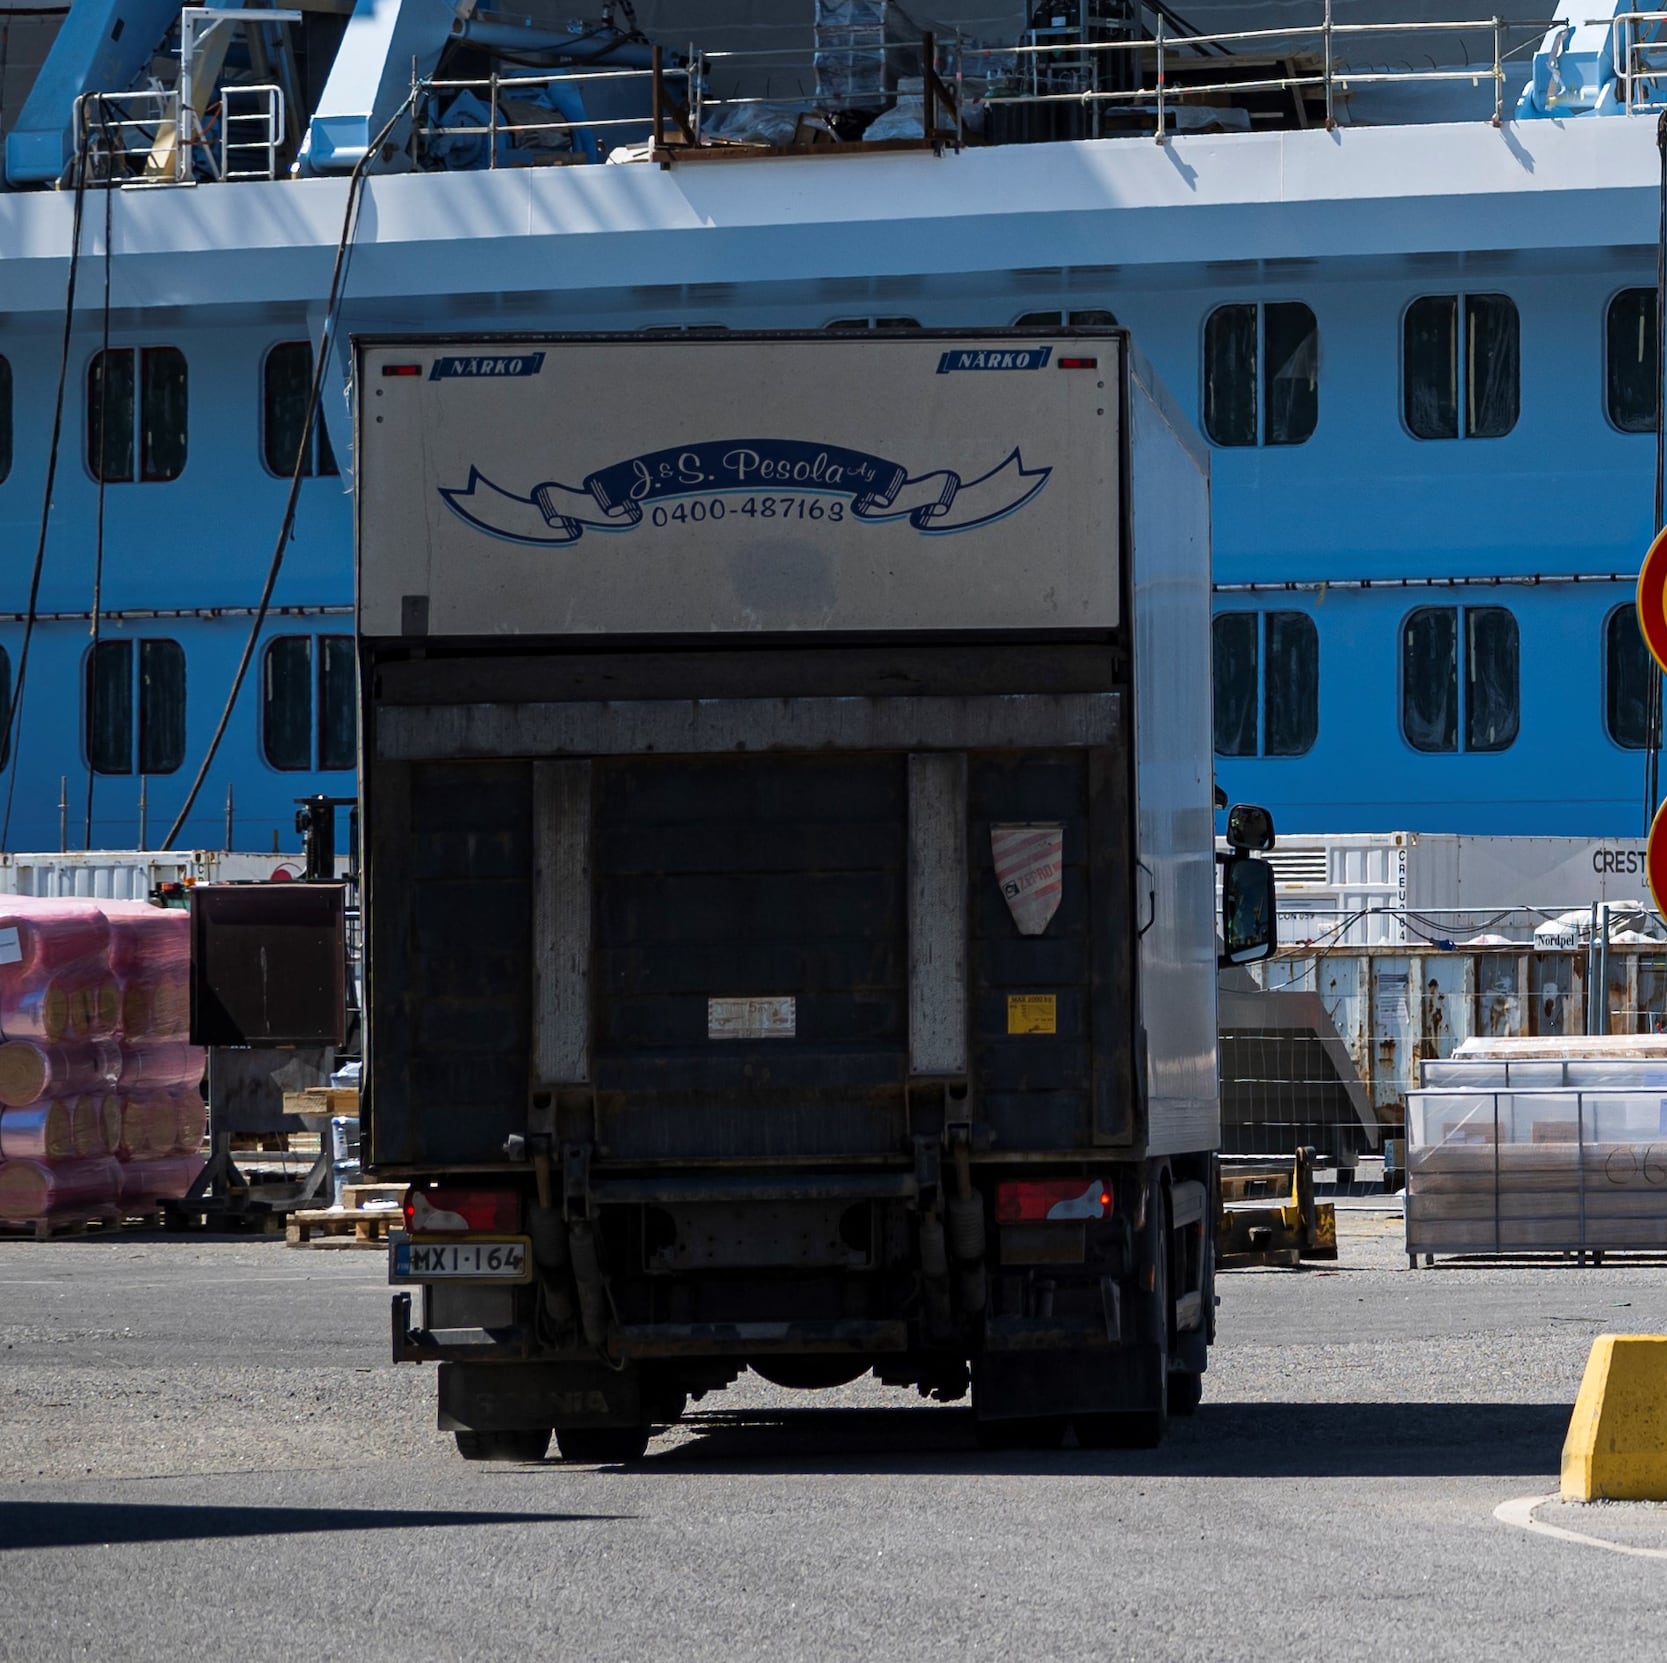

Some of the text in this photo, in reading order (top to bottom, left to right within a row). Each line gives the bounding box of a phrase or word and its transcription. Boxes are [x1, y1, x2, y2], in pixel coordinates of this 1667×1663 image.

[450, 358, 523, 374] NÄRKO
[957, 351, 1031, 368] NÄRKO
[722, 449, 844, 483] Pesola
[652, 497, 844, 527] 0400-487163
[1592, 850, 1647, 874] CREST
[1537, 934, 1575, 949] Nordpel
